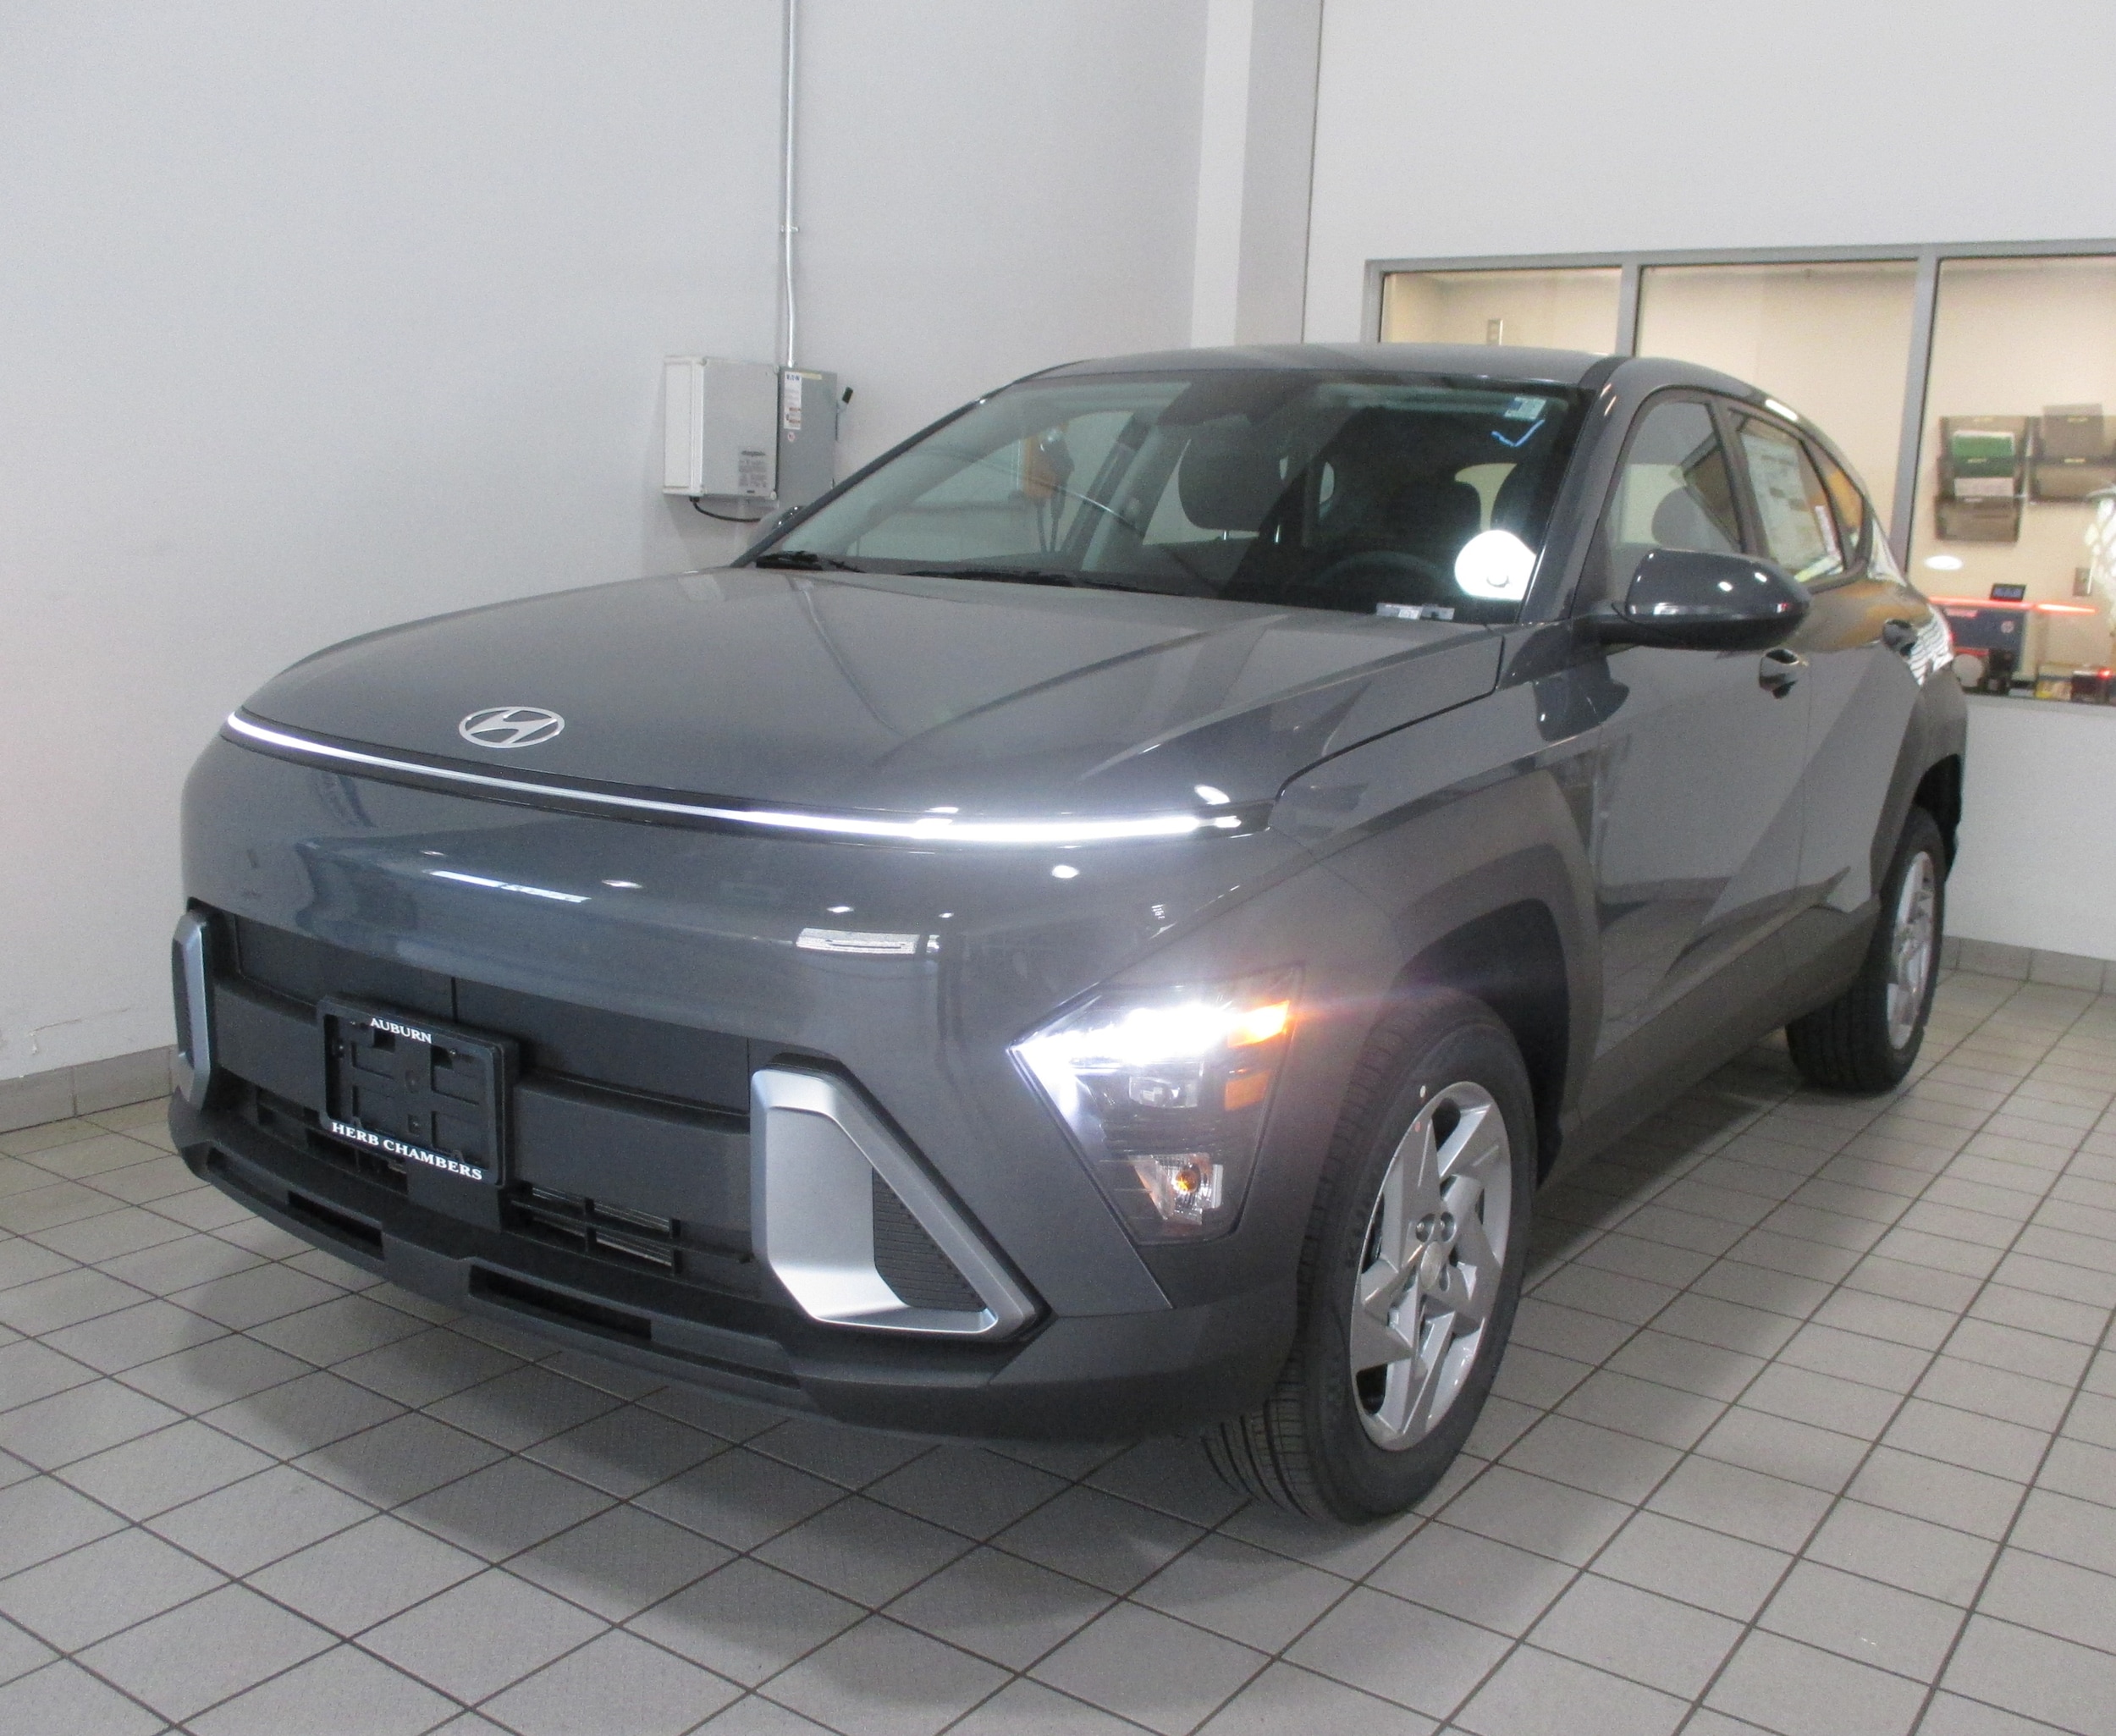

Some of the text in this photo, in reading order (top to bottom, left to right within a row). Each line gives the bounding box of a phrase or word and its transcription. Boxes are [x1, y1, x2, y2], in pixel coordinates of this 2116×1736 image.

[370, 1017, 433, 1044] AUBURN
[331, 1122, 483, 1181] HERB CHAMBERS
